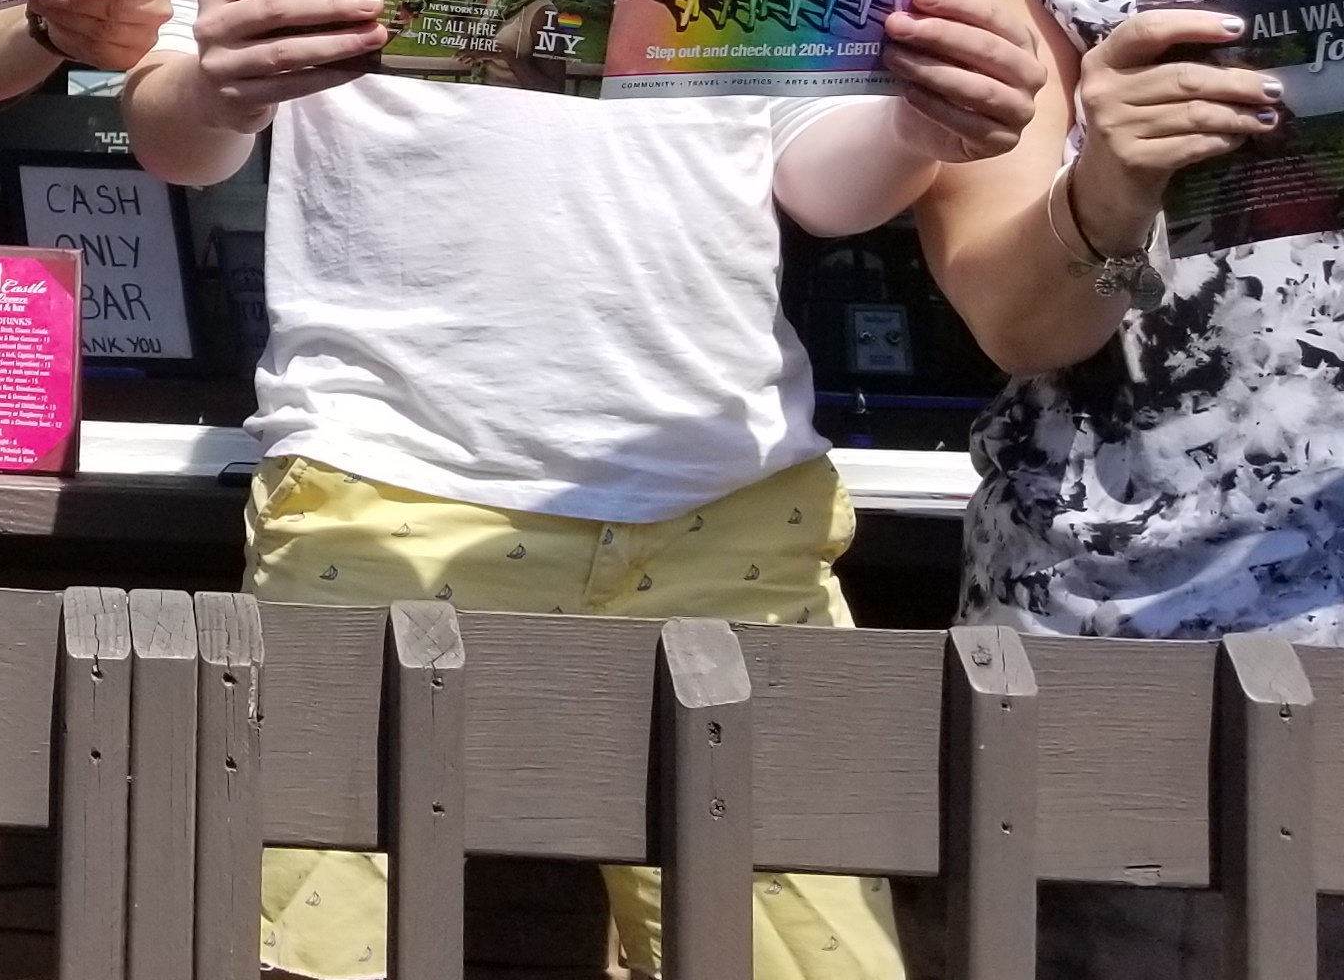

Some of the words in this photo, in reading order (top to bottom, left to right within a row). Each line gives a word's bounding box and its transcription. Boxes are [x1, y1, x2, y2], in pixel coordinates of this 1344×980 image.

[429, 3, 449, 12] NEW
[449, 5, 472, 14] YORK
[473, 8, 498, 17] STATE
[422, 17, 443, 31] IT'S
[445, 20, 465, 33] ALL
[544, 10, 558, 31] I
[1252, 10, 1297, 40] ALL
[417, 32, 438, 45] IT'S
[441, 35, 467, 49] only
[470, 38, 502, 53] HERE.
[534, 31, 585, 55] NY
[645, 45, 677, 61] Step
[678, 45, 701, 59] out
[703, 44, 728, 58] and
[730, 42, 771, 57] check
[774, 43, 796, 57] out
[799, 42, 834, 57] 200+
[46, 182, 142, 217] CASH
[1, 279, 47, 293] Castle
[82, 337, 124, 354] ANK
[130, 336, 161, 353] YOU
